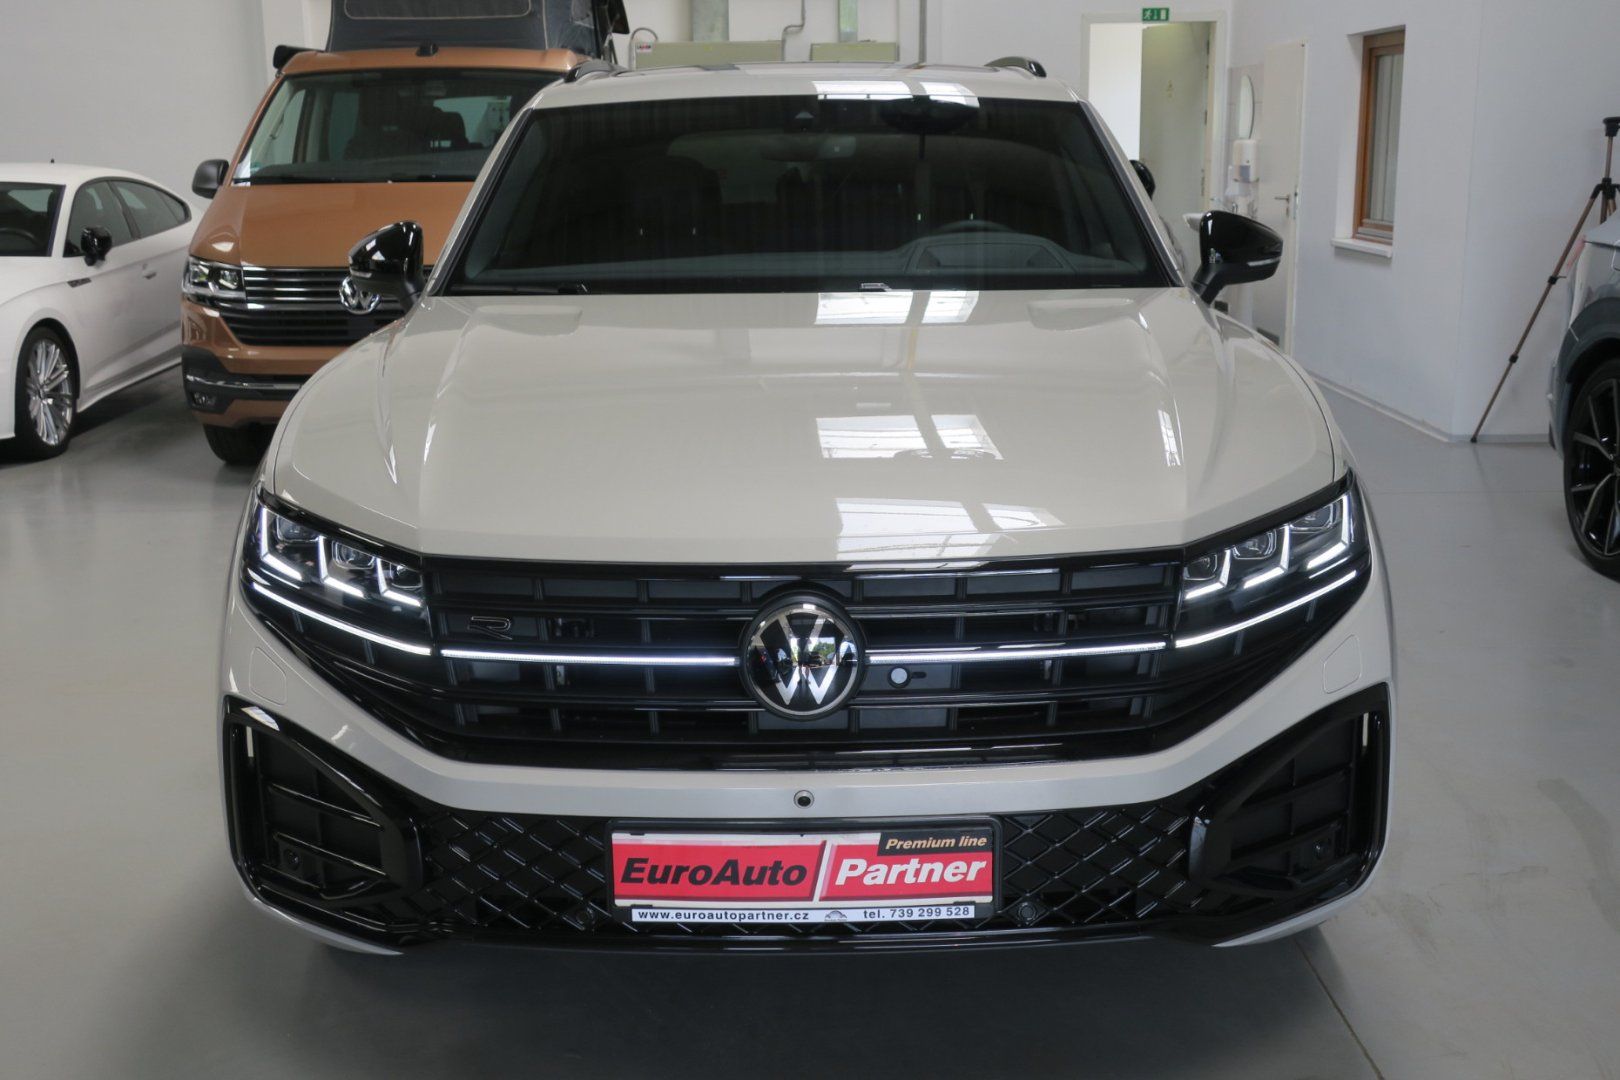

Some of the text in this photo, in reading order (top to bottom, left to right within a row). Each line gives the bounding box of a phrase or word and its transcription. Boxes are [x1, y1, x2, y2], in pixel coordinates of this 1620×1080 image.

[885, 836, 987, 850] Premium line
[620, 857, 808, 886] EuroAuto
[835, 858, 987, 885] Partner
[638, 911, 809, 922] www.euroautopartner.cz
[863, 906, 970, 919] tel. 739 299 528
